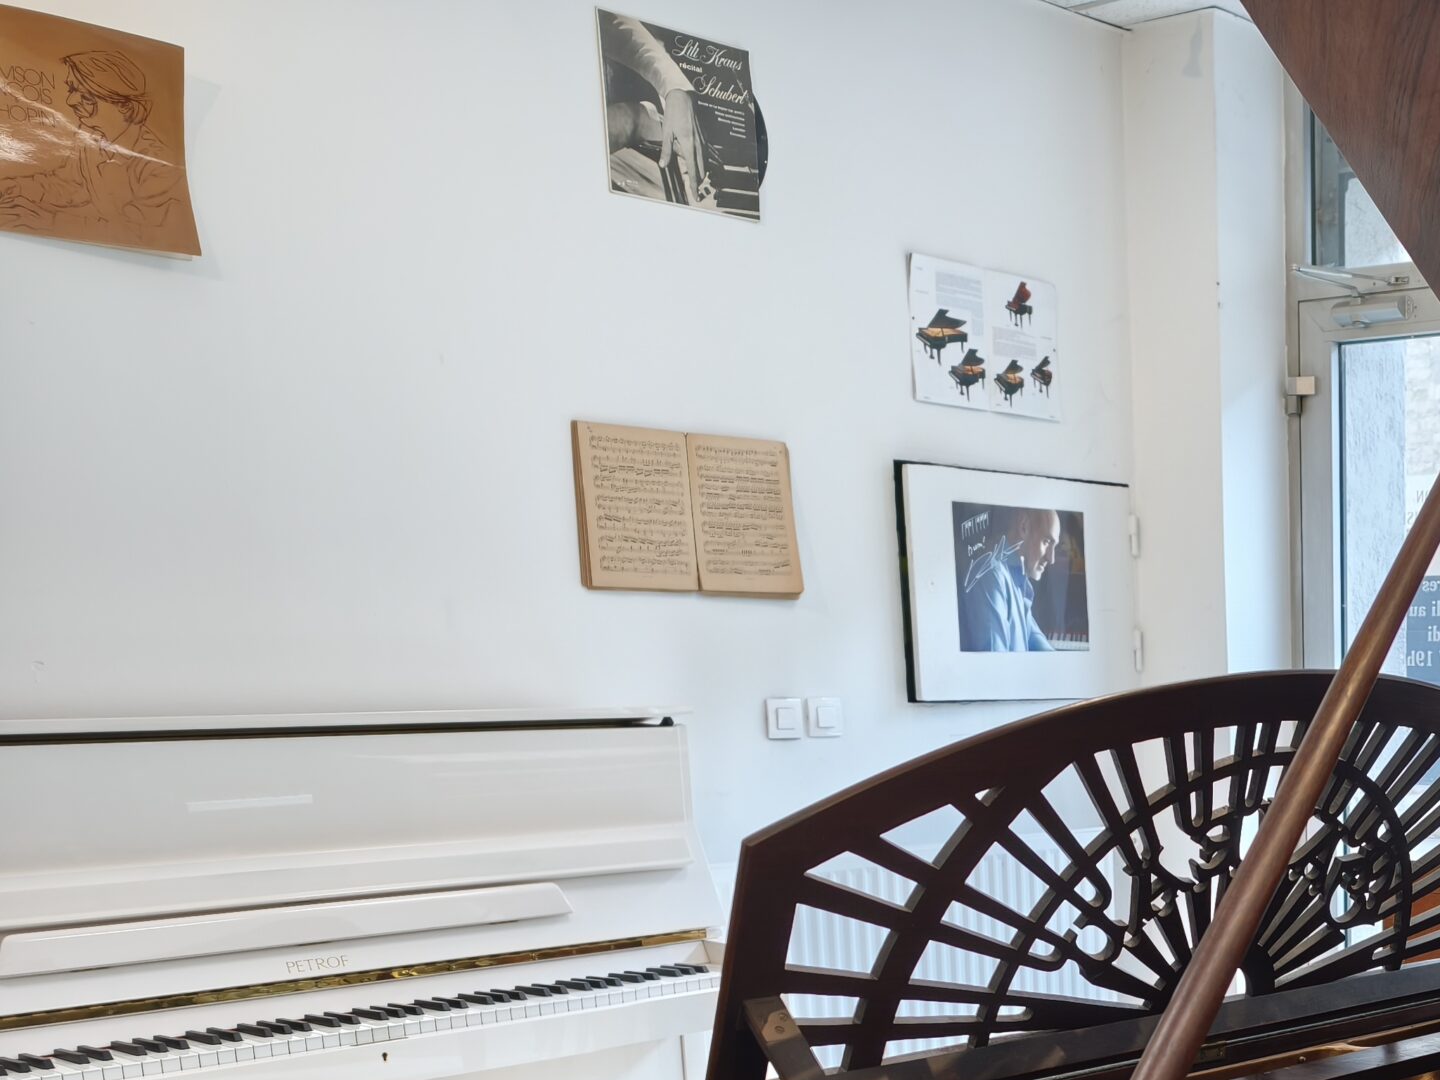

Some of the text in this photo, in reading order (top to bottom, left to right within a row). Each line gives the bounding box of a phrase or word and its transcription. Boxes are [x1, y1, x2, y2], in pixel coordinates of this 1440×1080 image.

[672, 35, 743, 71] Lili Kraus
[679, 62, 703, 73] récital
[692, 73, 748, 105] Schubert
[285, 954, 349, 974] PETROF
